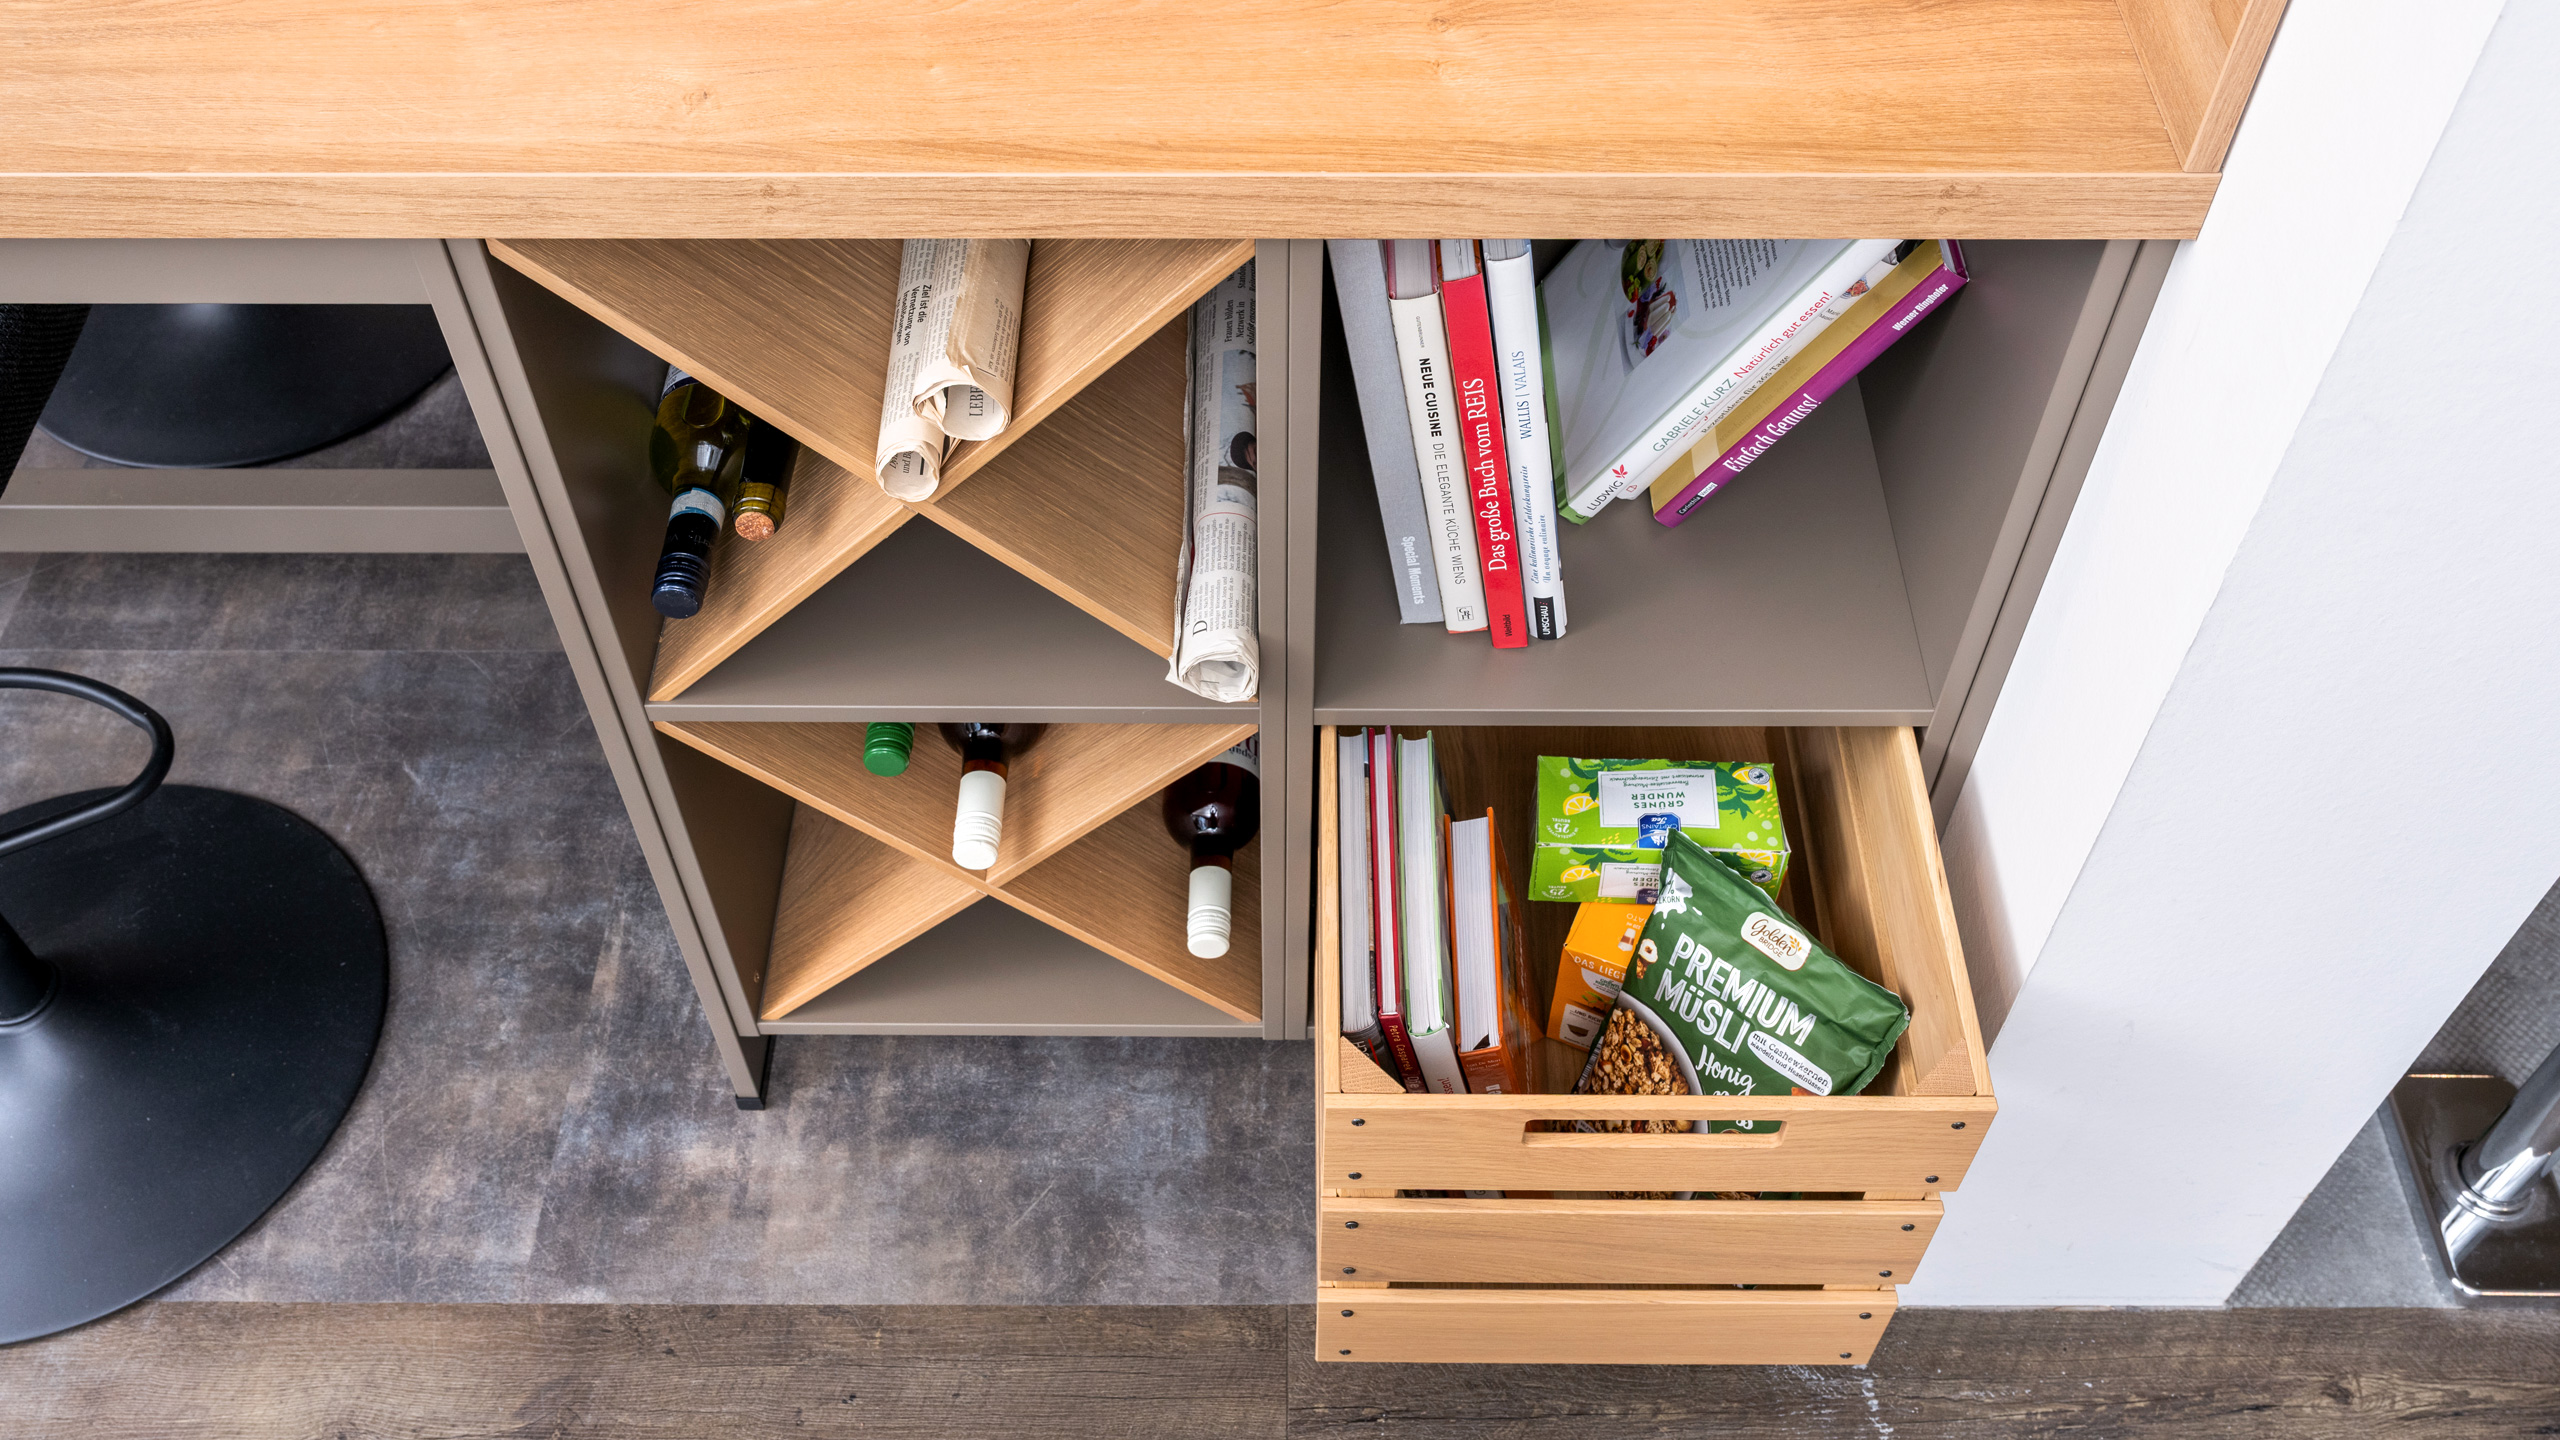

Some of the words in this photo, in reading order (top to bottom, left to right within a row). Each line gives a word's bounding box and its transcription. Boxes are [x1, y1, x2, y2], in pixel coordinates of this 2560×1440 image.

[919, 299, 928, 310] ist
[921, 283, 931, 299] Ziel
[904, 284, 919, 332] Vernetzung
[917, 310, 926, 323] die
[1225, 300, 1234, 320] bilden
[1236, 309, 1245, 338] Netzwerk
[1892, 310, 1918, 332] Werner
[1914, 283, 1949, 312] Ringhofer
[1224, 321, 1232, 343] Frauen
[1419, 357, 1434, 389] NEUE
[1512, 350, 1526, 391] VALAIS
[1652, 407, 1705, 452] GABRIELE
[1701, 378, 1737, 408] KURZ
[1733, 336, 1784, 378] Natürlich
[1782, 321, 1802, 339] gut
[1799, 291, 1833, 322] essen!
[1463, 378, 1487, 421] REIS
[1743, 384, 1758, 397] für
[1425, 392, 1442, 438] CUISINE
[1517, 400, 1532, 440] WALLIS
[1477, 422, 1494, 458] vom
[1722, 434, 1778, 473] Einfach
[1766, 393, 1822, 437] Genuss!
[1433, 443, 1446, 460] DIE
[1436, 464, 1455, 514] ELEGANTE
[1474, 459, 1498, 499] Buch
[1586, 480, 1624, 511] LUDWIG
[1678, 496, 1701, 515] Carinthia
[1446, 518, 1461, 551] KÜCHE
[1480, 500, 1510, 542] große
[1402, 536, 1420, 568] Special
[1488, 544, 1508, 572] Das
[1525, 524, 1537, 569] kulinarische
[1451, 554, 1466, 585] WIENS
[1531, 569, 1539, 584] Eine
[1408, 568, 1424, 605] Moments
[1502, 614, 1512, 638] Weltbild
[1540, 606, 1550, 636] UMSCHAU
[1631, 791, 1685, 800] WUNDER
[1633, 800, 1684, 809] GRÜNES
[1553, 822, 1569, 833] 25
[1550, 888, 1565, 896] 25
[1750, 918, 1797, 957] Golden
[1758, 936, 1784, 958] BRIDGE
[1574, 956, 1595, 969] DAS
[1599, 965, 1626, 981] LIEGT
[1669, 932, 1817, 1046] PREMIUM
[1654, 968, 1751, 1054] MÜSLI
[1753, 1033, 1767, 1046] mit
[1388, 1024, 1400, 1042] Petra
[1397, 1044, 1414, 1072] Casparek
[1406, 1076, 1420, 1089] Die
[1695, 1044, 1757, 1096] Honig
[1750, 1041, 1775, 1061] Mandeln
[1775, 1058, 1787, 1069] und
[1787, 1066, 1825, 1093] Haselnüssen
